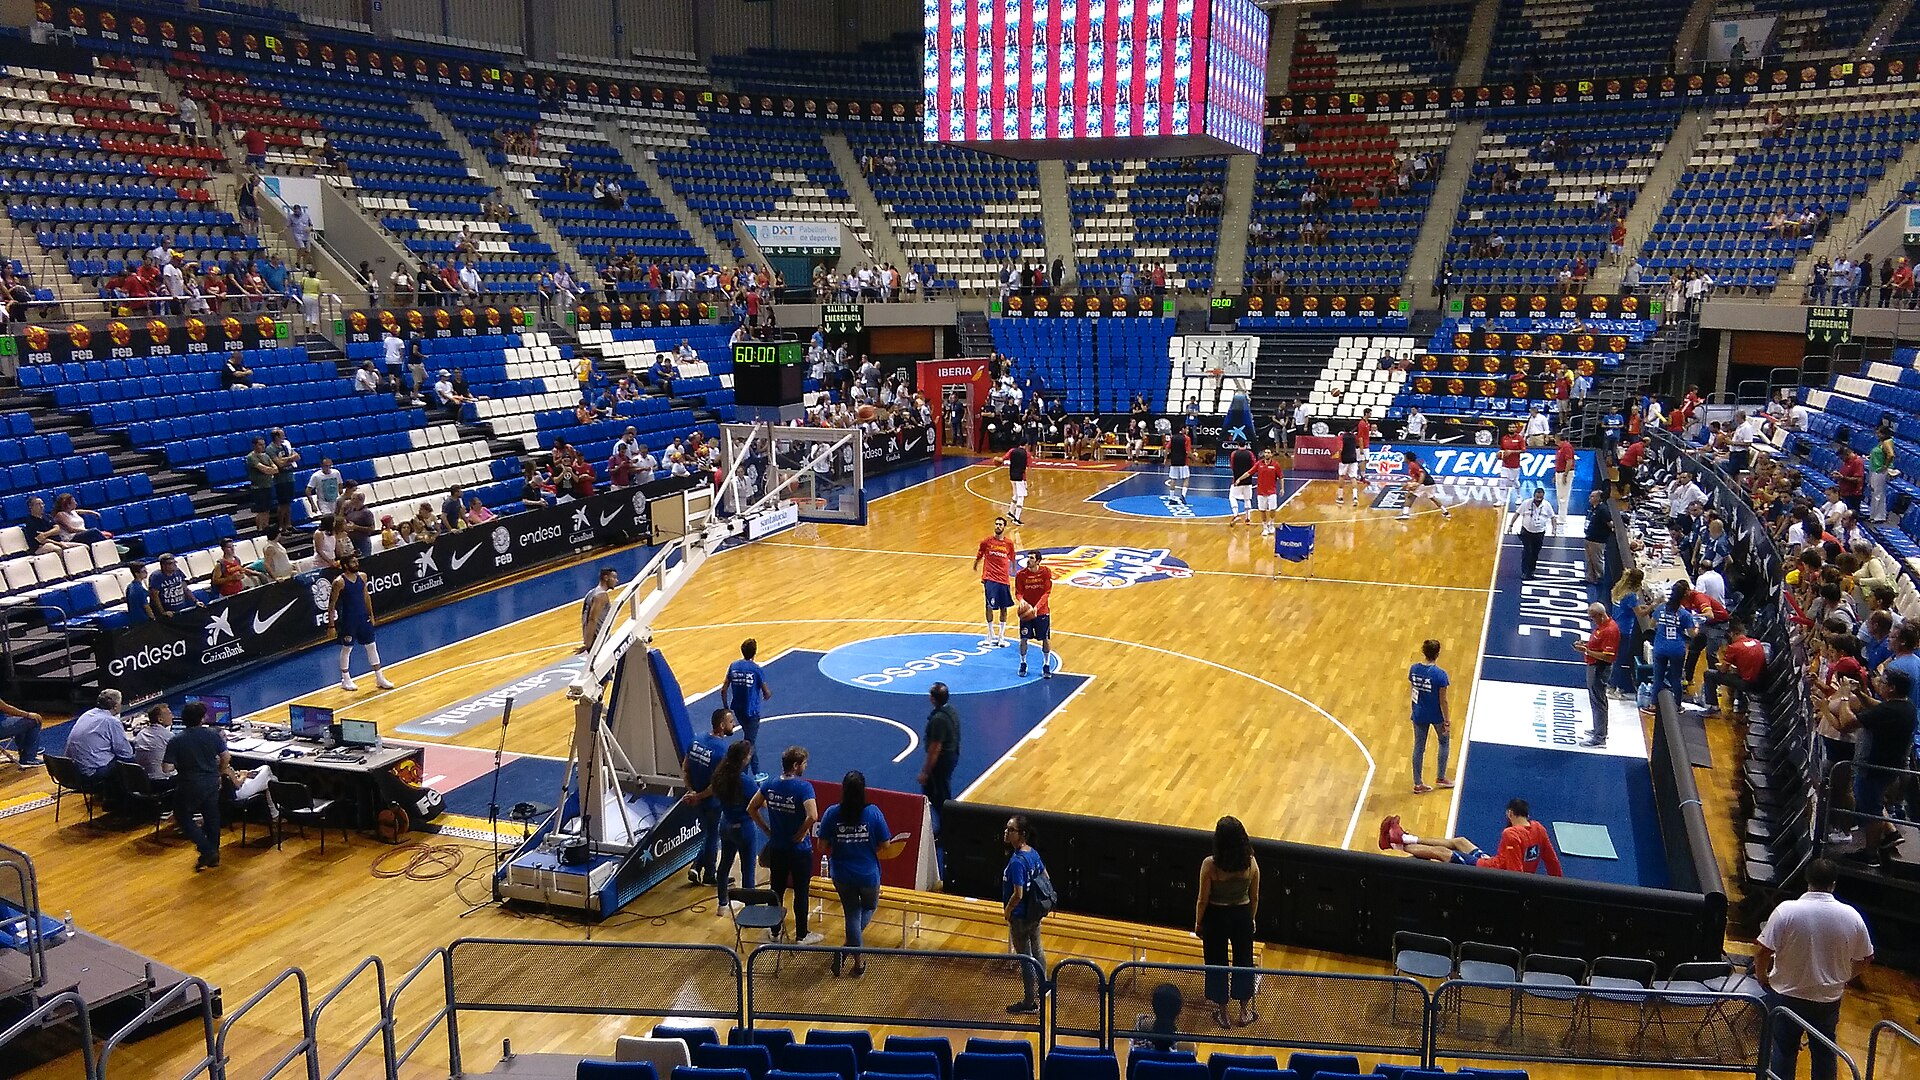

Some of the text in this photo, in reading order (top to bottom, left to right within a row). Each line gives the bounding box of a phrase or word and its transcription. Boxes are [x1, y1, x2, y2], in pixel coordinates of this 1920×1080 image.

[773, 226, 794, 235] DXT
[1813, 308, 1835, 316] SALIDA
[1809, 319, 1849, 329] EMERGENCIA
[736, 347, 775, 362] 60:00
[938, 367, 972, 377] IBERIA
[1435, 450, 1580, 477] TENRIF
[520, 524, 562, 547] endesa
[412, 577, 444, 594] CaixaBank
[1519, 561, 1591, 641] TENERIFE
[108, 639, 186, 677] endesa
[201, 643, 245, 664] CaixaBank
[654, 817, 701, 858] CaixaBank
